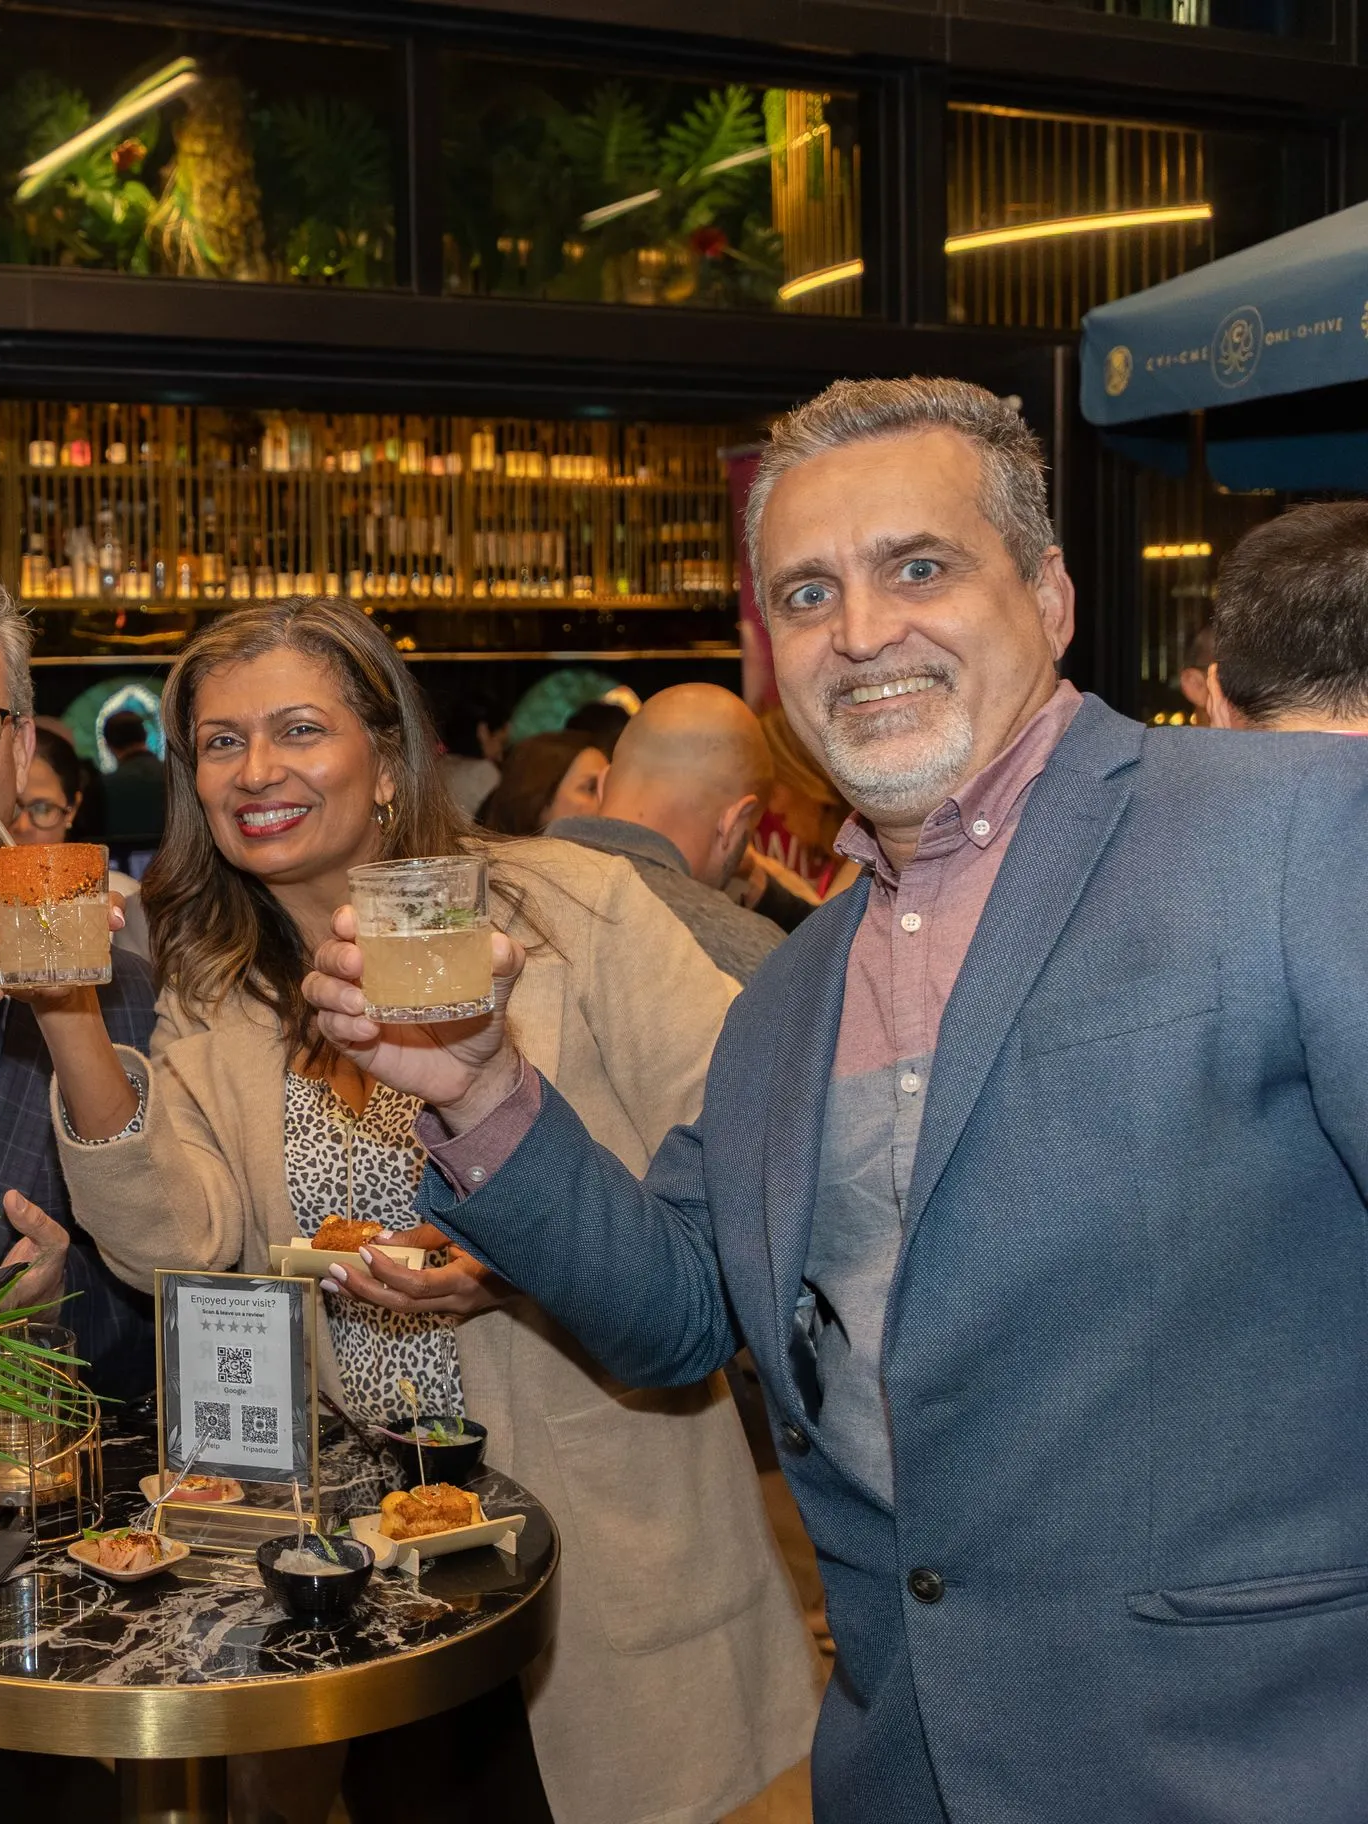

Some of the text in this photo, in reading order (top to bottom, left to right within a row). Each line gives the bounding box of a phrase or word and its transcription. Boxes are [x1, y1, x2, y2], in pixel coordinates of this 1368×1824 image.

[190, 1294, 276, 1308] Enjoyed your visit?
[224, 1386, 247, 1396] Google
[242, 1445, 279, 1455] Tripadvisor
